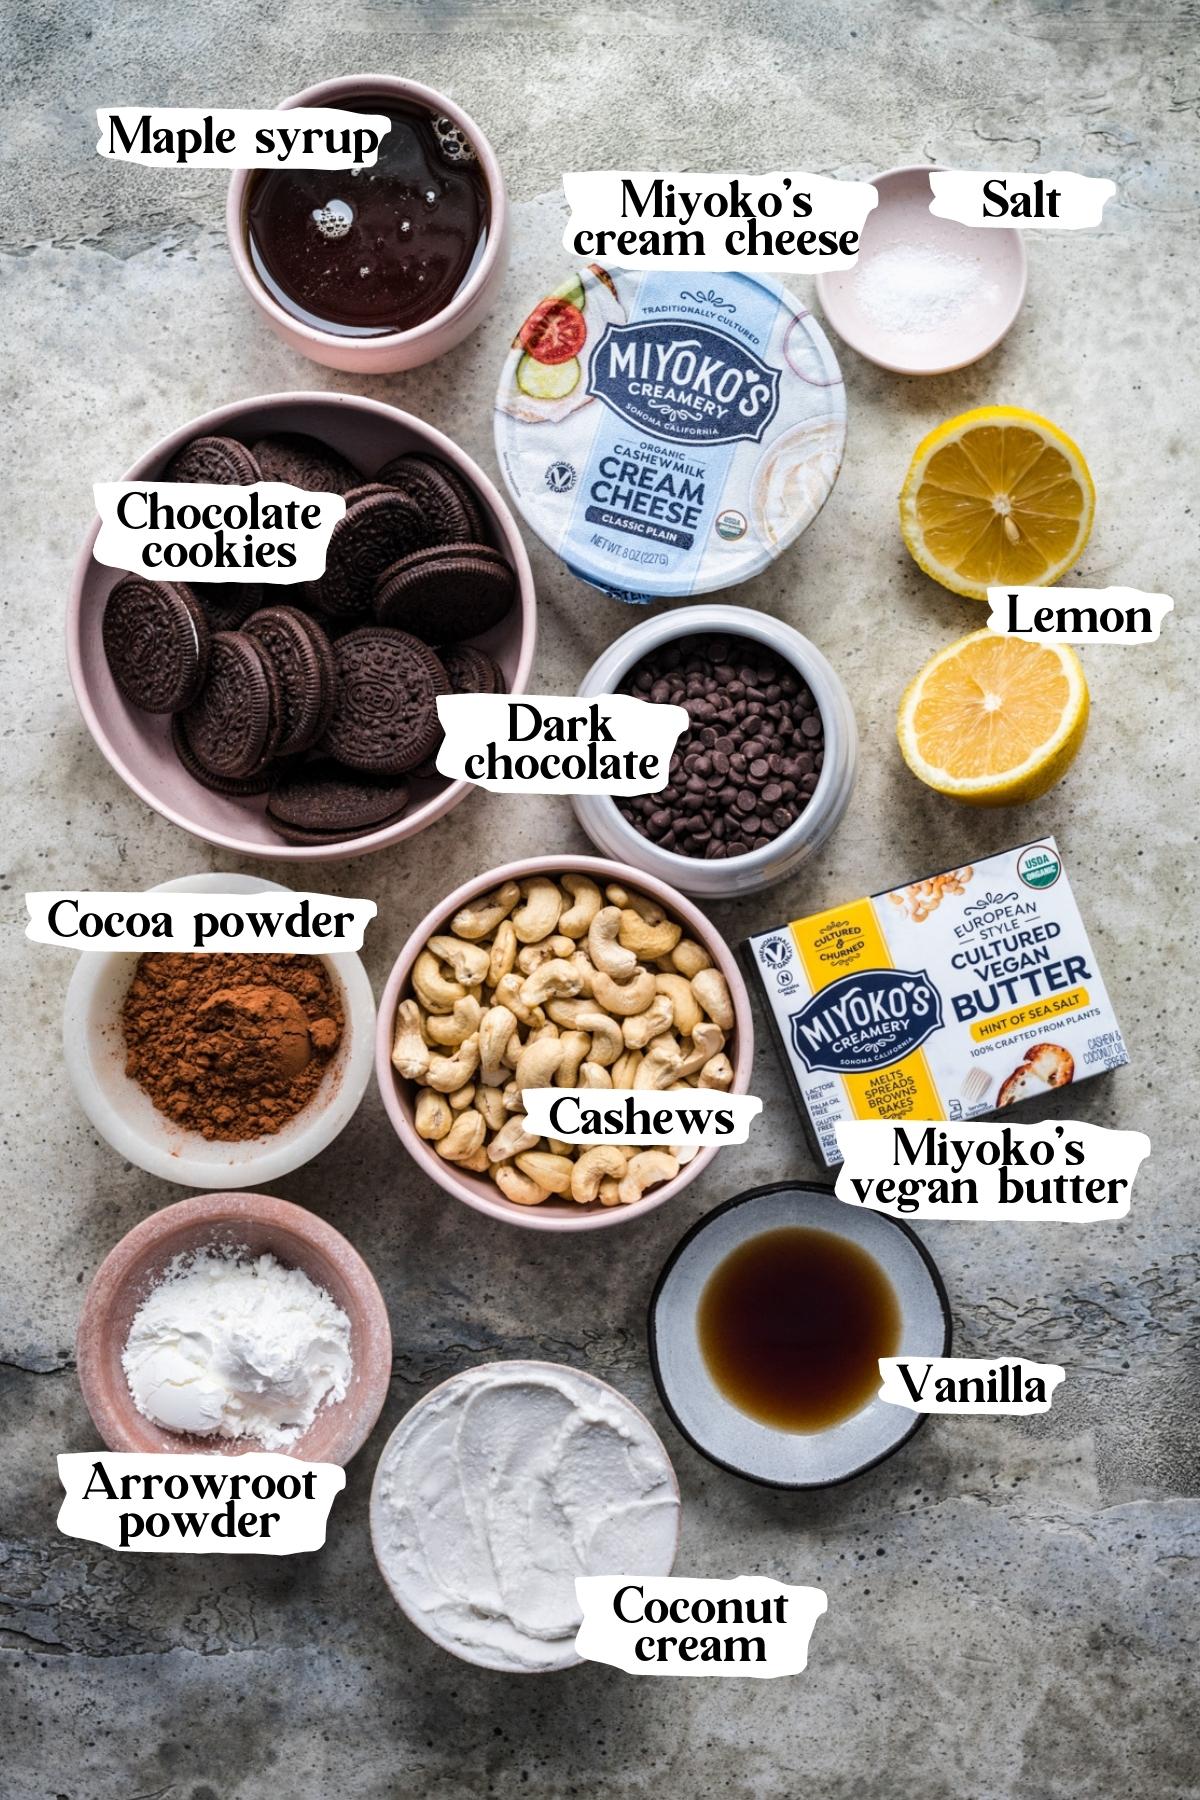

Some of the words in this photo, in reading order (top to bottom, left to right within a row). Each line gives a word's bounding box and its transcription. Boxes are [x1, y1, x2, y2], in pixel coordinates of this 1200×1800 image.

[642, 304, 717, 320] TRADITIONALLY
[717, 314, 760, 346] CULTURED
[608, 339, 770, 417] MIYOKO'S
[627, 381, 729, 419] CREAMERY
[625, 402, 662, 427] SONOMA
[663, 422, 719, 435] CALIFORNIA
[613, 444, 673, 469] CASHEW
[672, 462, 706, 480] MILK
[640, 441, 686, 461] ORGANIC
[598, 455, 706, 506] CREAM
[590, 480, 703, 530] CHEESE
[590, 533, 609, 549] NET
[601, 513, 645, 533] CLASSIC
[645, 526, 678, 542] PLAIN
[1025, 854, 1050, 869] USDA
[1026, 864, 1057, 881] ORGANIC
[953, 902, 1037, 938] EUROPEAN
[979, 918, 1020, 940] STYLE
[814, 927, 862, 948] CULTURED
[820, 941, 865, 961] CHURNED
[836, 938, 845, 949] &
[951, 921, 1061, 970] CULTURED
[973, 945, 1051, 982] VEGAN
[951, 955, 1092, 1023] BUTTER
[800, 980, 931, 1052] MIYOKO'S
[979, 1018, 1008, 1036] HINT
[1010, 1013, 1027, 1026] OF
[1028, 1005, 1052, 1021] SEA
[1052, 994, 1080, 1011] SALT
[832, 1018, 910, 1053] CREAMERY
[970, 1043, 995, 1058] 100%
[995, 1029, 1037, 1049] CRAFTED
[1038, 1020, 1065, 1036] FROM
[1065, 1007, 1101, 1026] PLANTS
[840, 1056, 872, 1066] SONOMA
[874, 1036, 914, 1061] CALIFORNIA
[805, 1081, 835, 1097] LACTOSE
[864, 1076, 915, 1099] SPREADS
[869, 1069, 904, 1088] MELTS
[867, 1085, 918, 1109] BROWNS
[878, 1096, 914, 1116] BAKES
